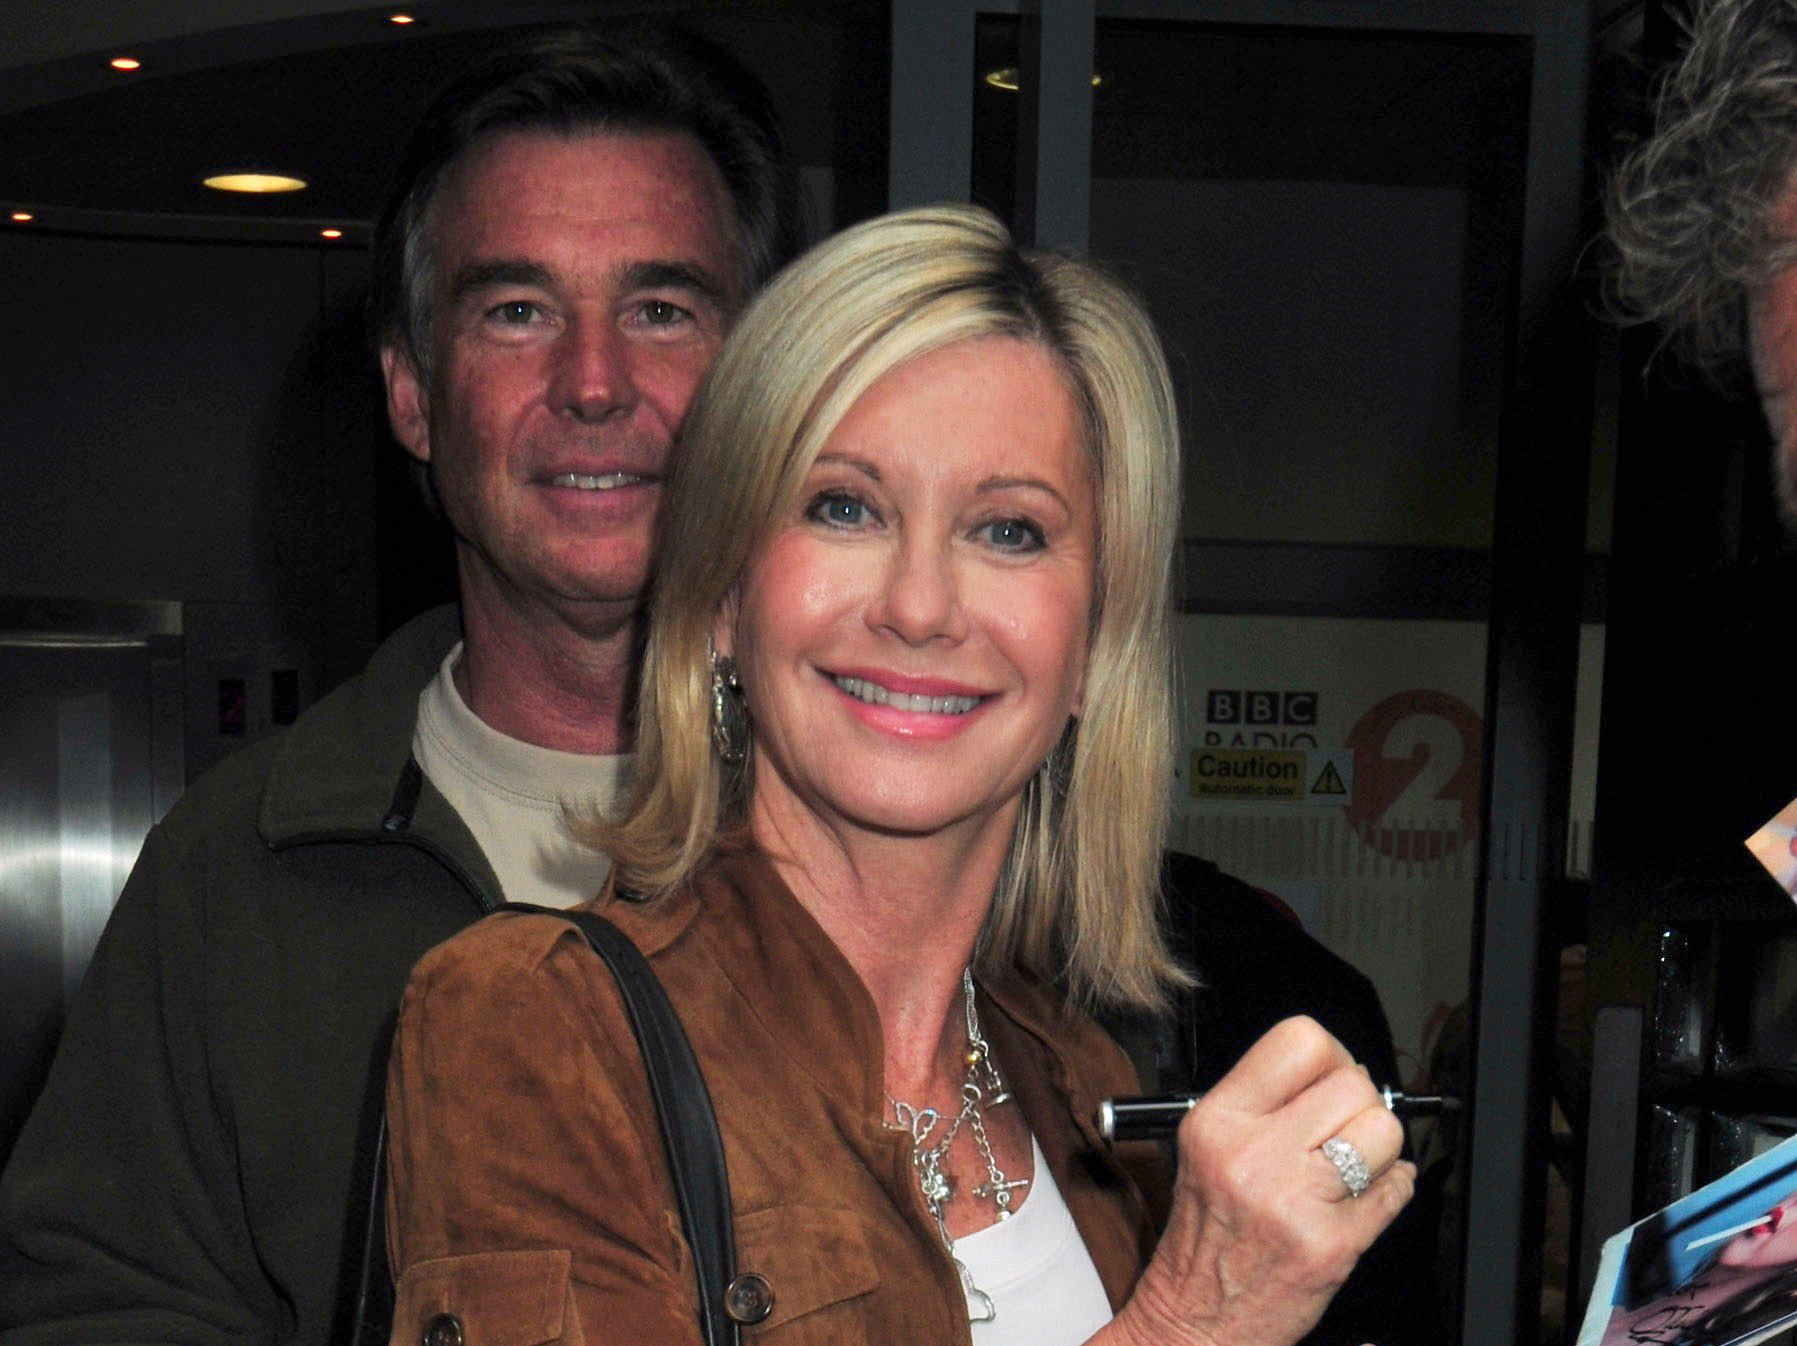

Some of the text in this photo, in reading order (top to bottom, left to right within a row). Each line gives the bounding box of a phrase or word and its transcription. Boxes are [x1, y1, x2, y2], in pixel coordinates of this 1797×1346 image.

[1207, 691, 1318, 725] BBC
[1198, 755, 1298, 778] Caution
[1382, 713, 1466, 830] 2
